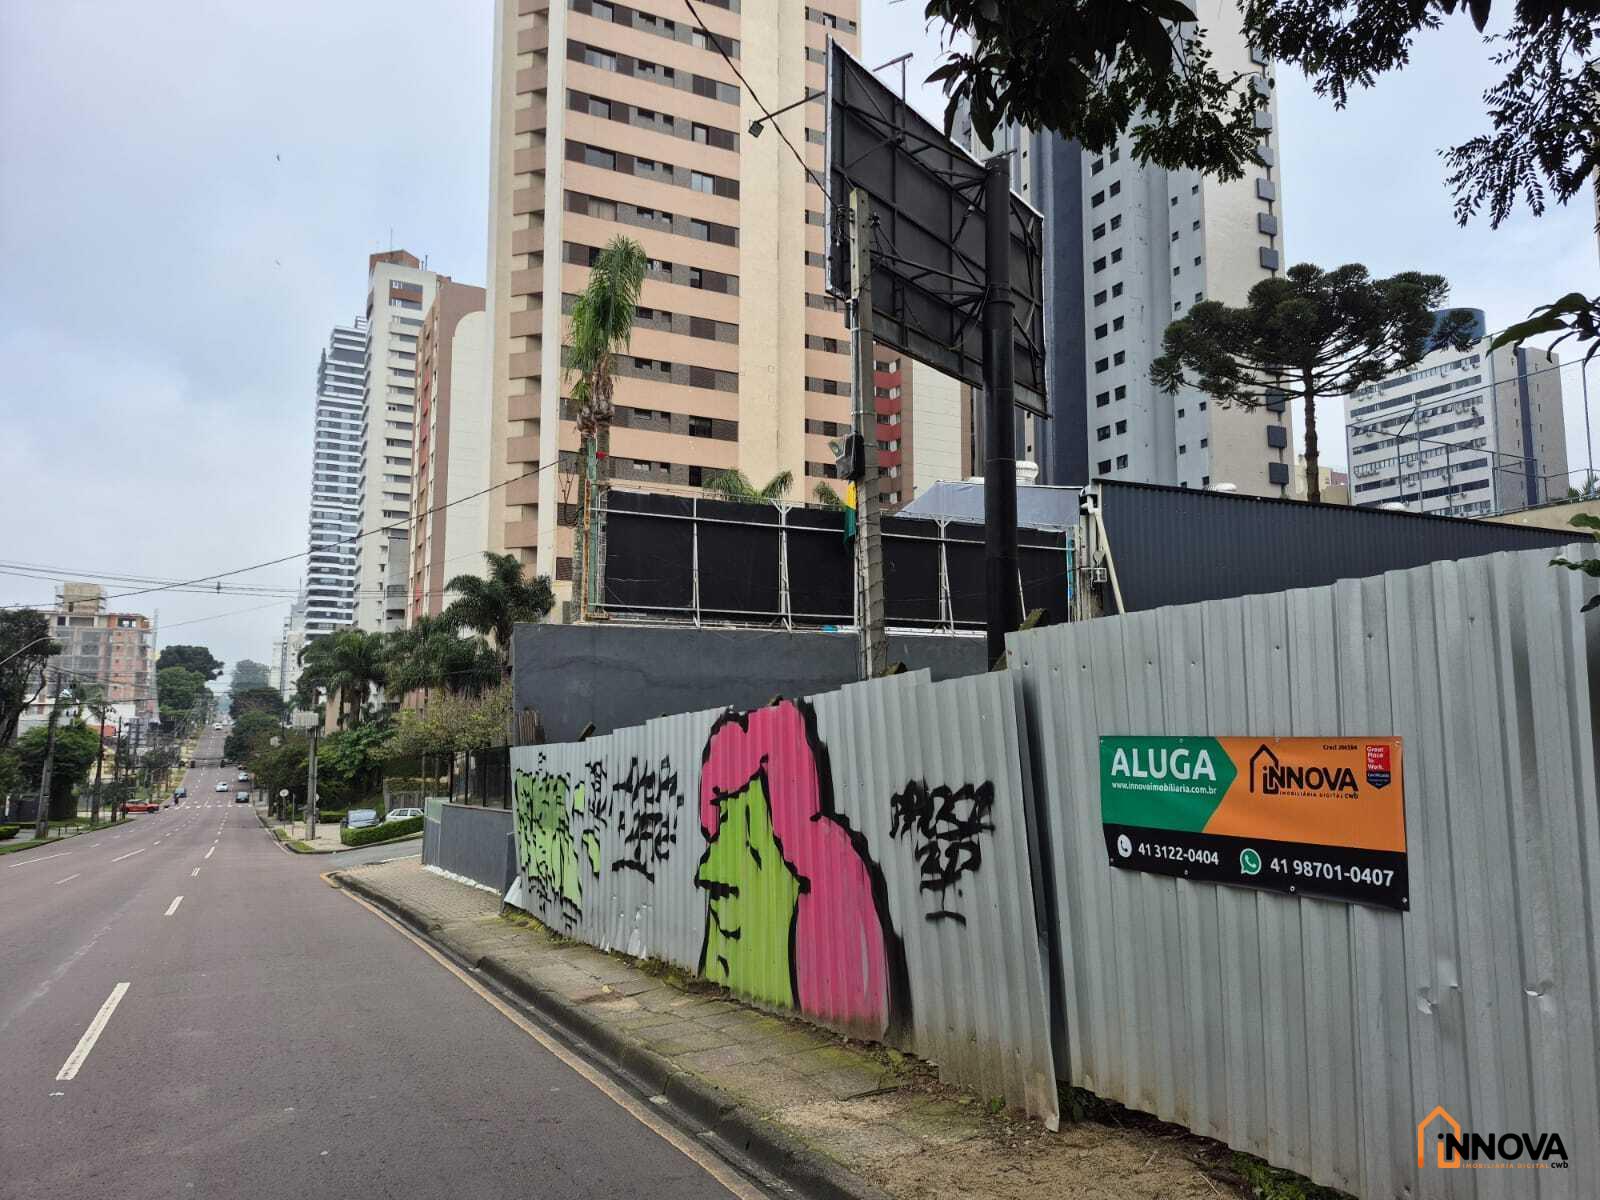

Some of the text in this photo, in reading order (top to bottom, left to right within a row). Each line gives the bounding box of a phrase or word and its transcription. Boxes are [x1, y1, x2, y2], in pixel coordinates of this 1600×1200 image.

[1111, 748, 1216, 781] ALUGA
[1111, 781, 1217, 794] www.innovaimobiliaria.com.br
[1138, 842, 1219, 865] 41 3122-0404
[1270, 858, 1394, 887] 41 98701-0407
